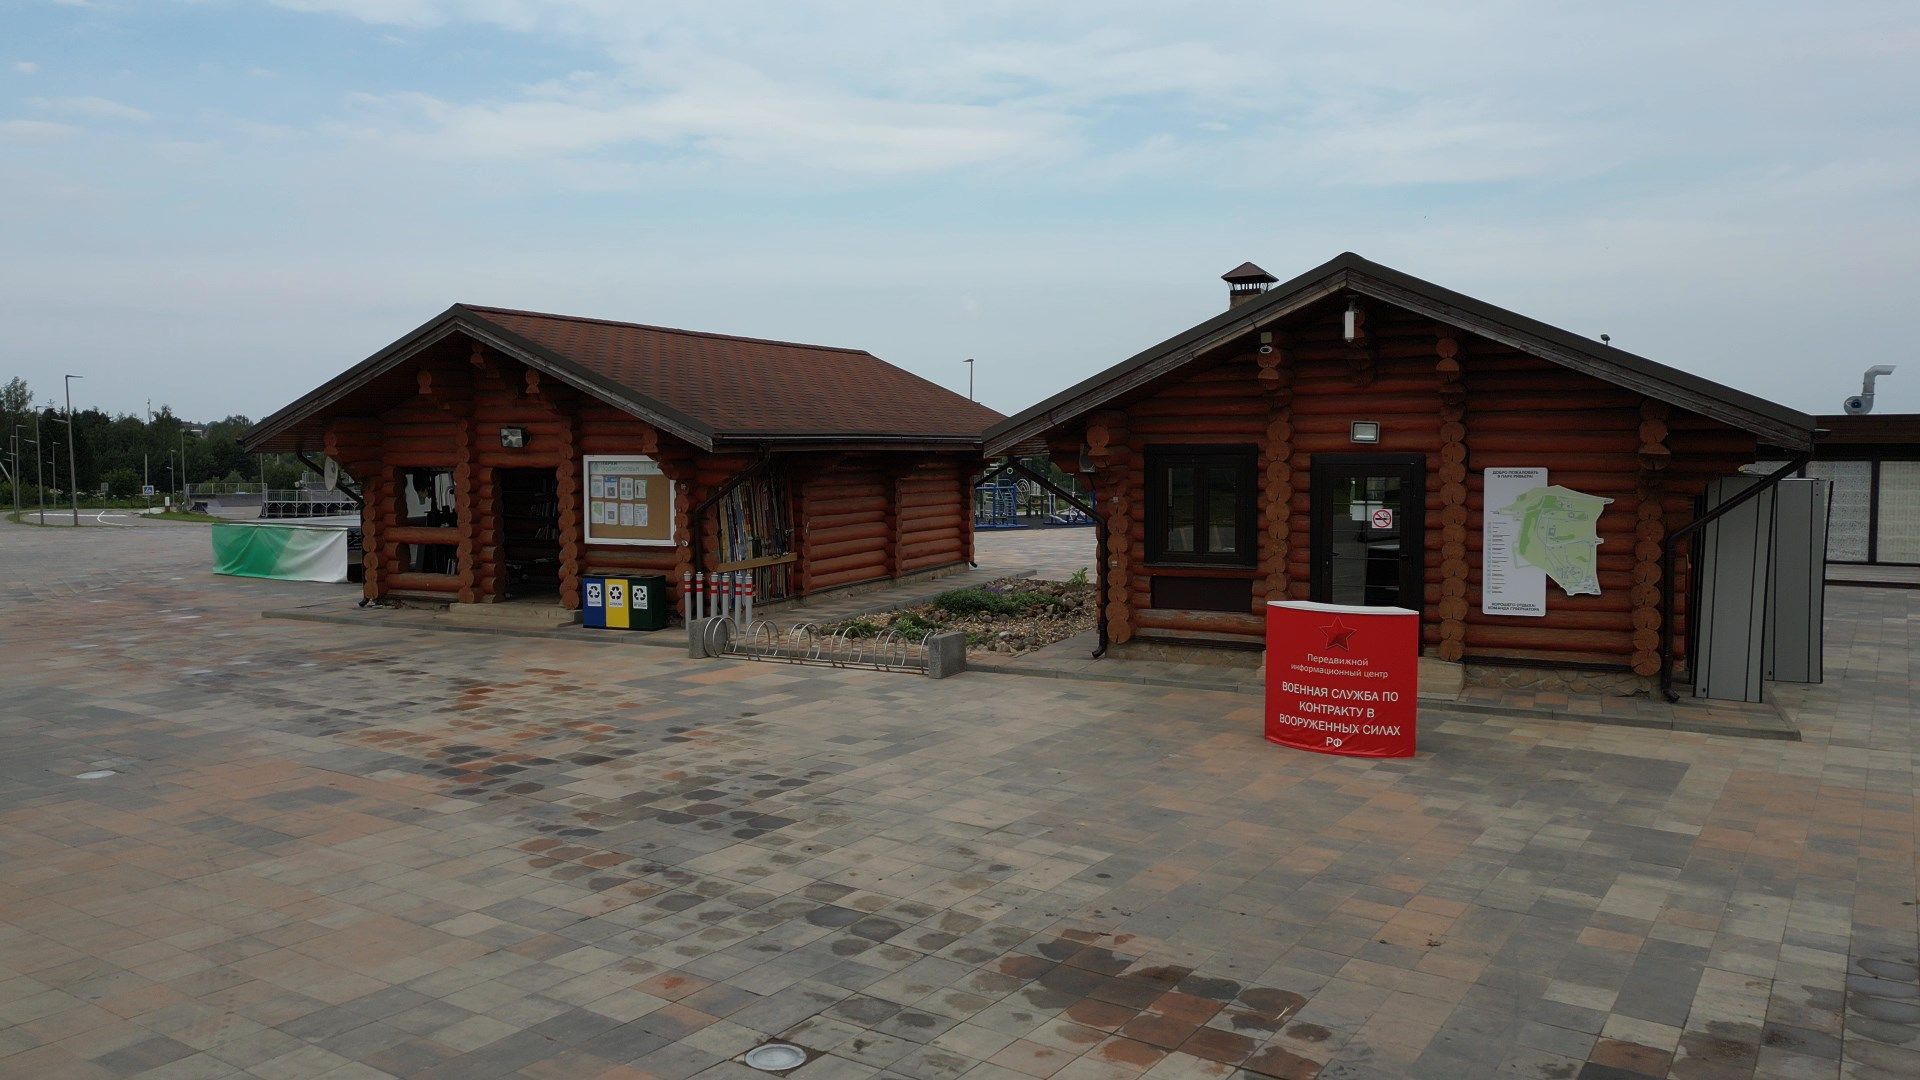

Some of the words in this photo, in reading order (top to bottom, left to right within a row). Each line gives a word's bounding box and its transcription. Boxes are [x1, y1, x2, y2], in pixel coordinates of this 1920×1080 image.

[1307, 653, 1368, 666] Передвижной
[1290, 664, 1362, 678] информационный
[1364, 671, 1388, 679] центр
[1282, 681, 1328, 698] ВОЕННАЯ
[1331, 688, 1379, 702] СЛУЖБА
[1382, 692, 1398, 702] ПО
[1299, 701, 1364, 718] КОНТРАКТУ
[1366, 708, 1375, 718] В
[1280, 713, 1360, 734] ВООРУЖЕННЫХ
[1362, 724, 1400, 736] СИЛАХ
[1326, 736, 1342, 748] РФ
